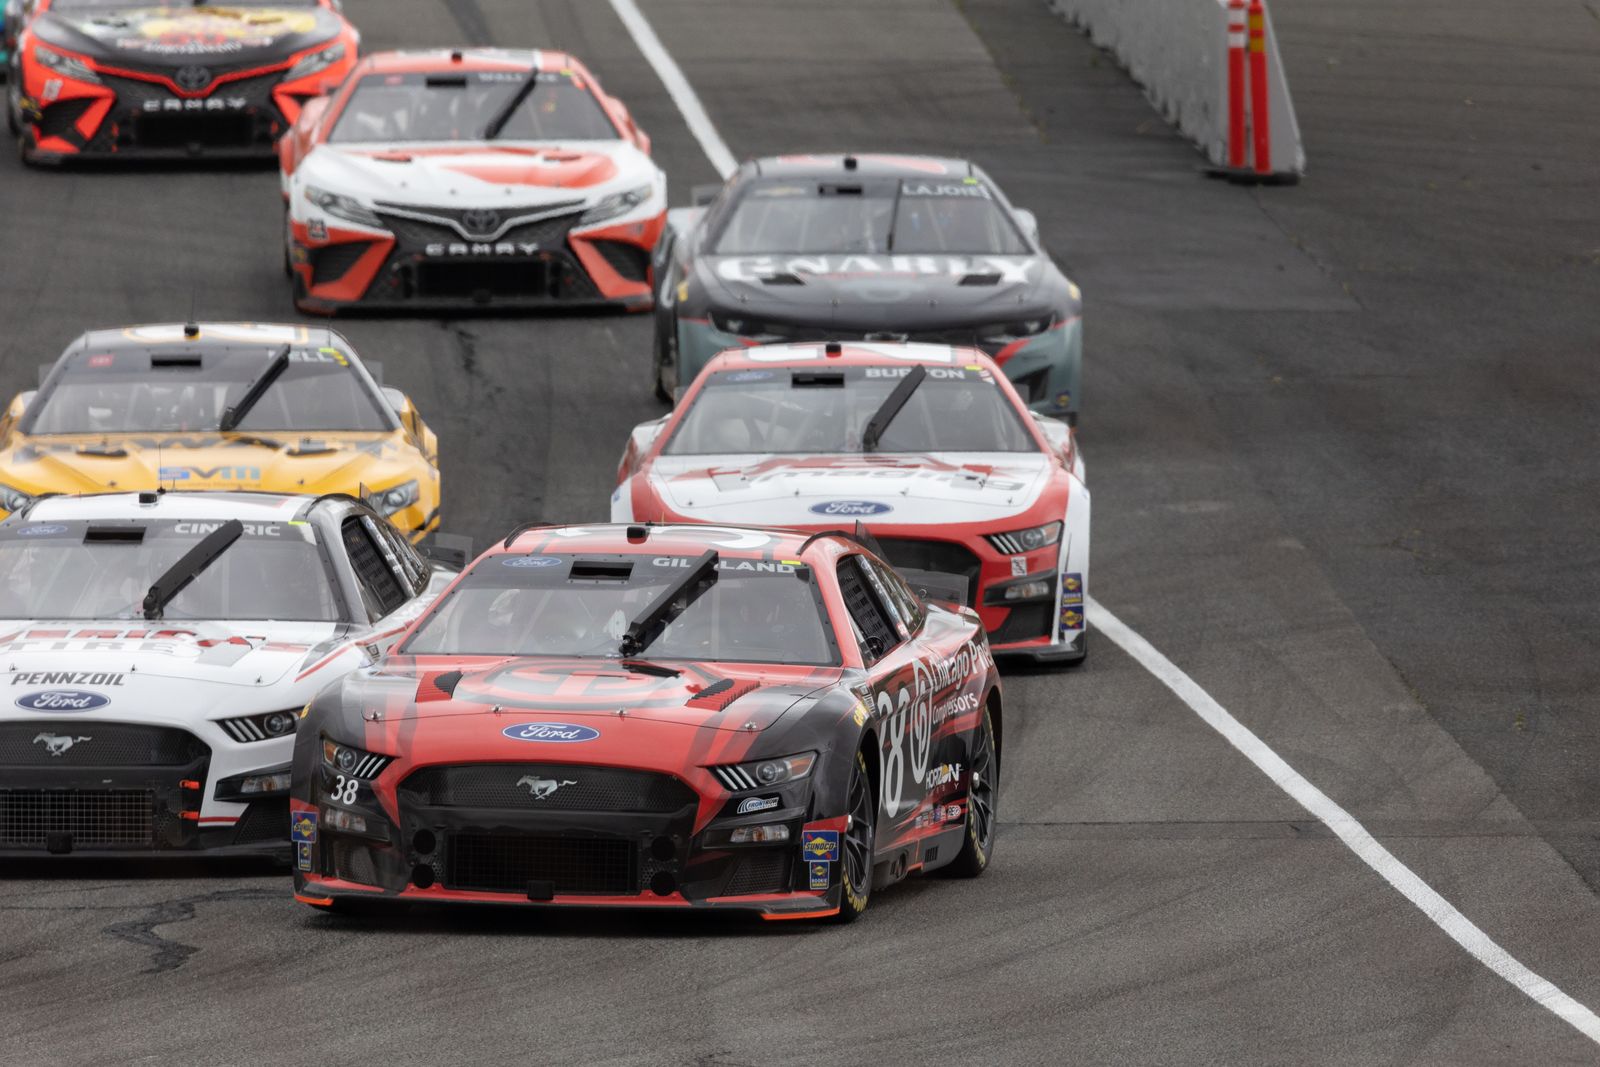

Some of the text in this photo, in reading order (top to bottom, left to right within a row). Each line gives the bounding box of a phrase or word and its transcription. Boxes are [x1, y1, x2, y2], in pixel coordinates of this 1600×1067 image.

[425, 243, 540, 256] CAMRY
[268, 351, 334, 362] ELL
[865, 367, 965, 379] BURON
[825, 501, 876, 514] Ford
[174, 523, 280, 536] CINRIC
[652, 557, 795, 573] GILLAND
[11, 672, 125, 686] PENNZOIL
[34, 691, 93, 708] Ford
[520, 724, 580, 739] Ford
[331, 774, 359, 805] 38
[804, 842, 836, 850] SUNOCO
